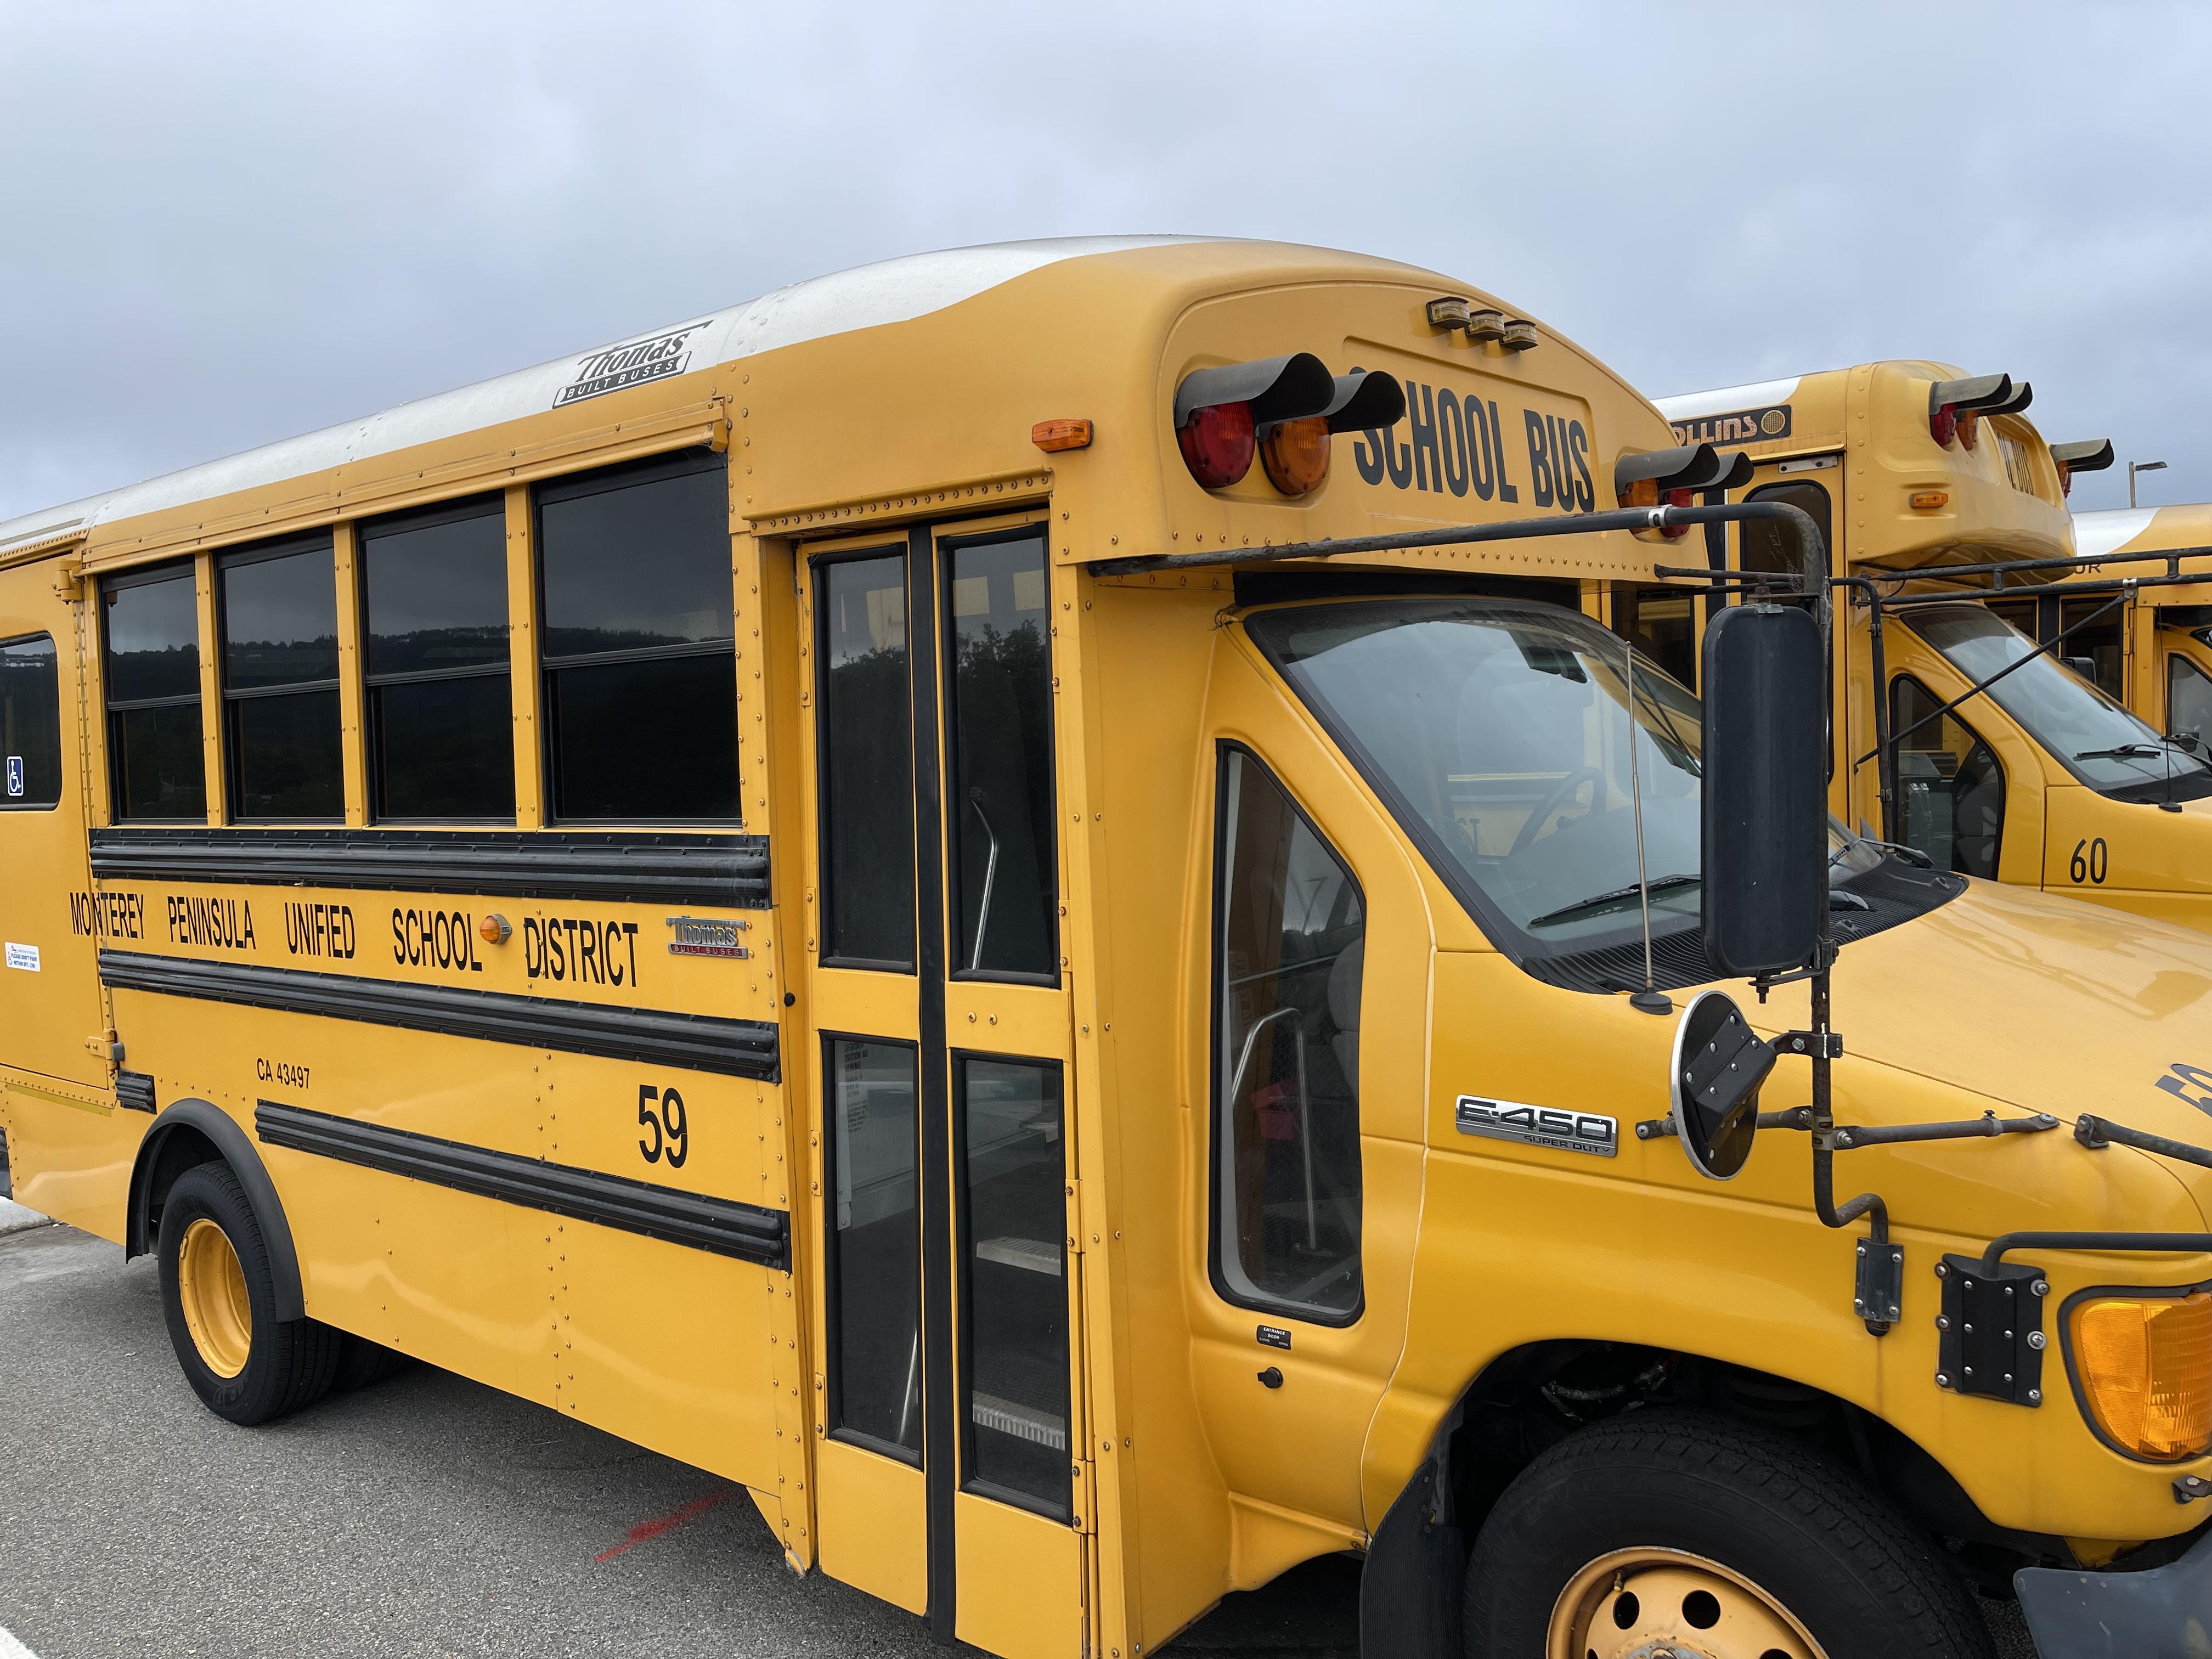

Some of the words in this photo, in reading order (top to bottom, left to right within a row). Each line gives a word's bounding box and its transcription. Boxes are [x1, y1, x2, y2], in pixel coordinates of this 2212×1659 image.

[575, 320, 714, 382] Thomas
[567, 377, 611, 398] BUILT
[618, 359, 675, 384] BUSES
[1523, 409, 1595, 513] BUS
[2070, 837, 2107, 884] 60
[70, 892, 144, 939] MONTEREY
[167, 895, 257, 950] PENINSULA
[285, 902, 356, 959] UNIFIED
[392, 908, 483, 972] SCHOOL
[524, 917, 639, 988] DISTRICT
[666, 915, 747, 947] Thomas
[674, 945, 701, 953] BUILT
[706, 947, 740, 957] BUSES
[257, 1058, 273, 1082] CA
[277, 1063, 309, 1089] 43497
[639, 1084, 687, 1169] 59
[1459, 1098, 1612, 1142] E-450
[1524, 1135, 1568, 1148] SUPER
[1573, 1143, 1611, 1153] DUTY
[1263, 1327, 1285, 1336] ENTRANCE
